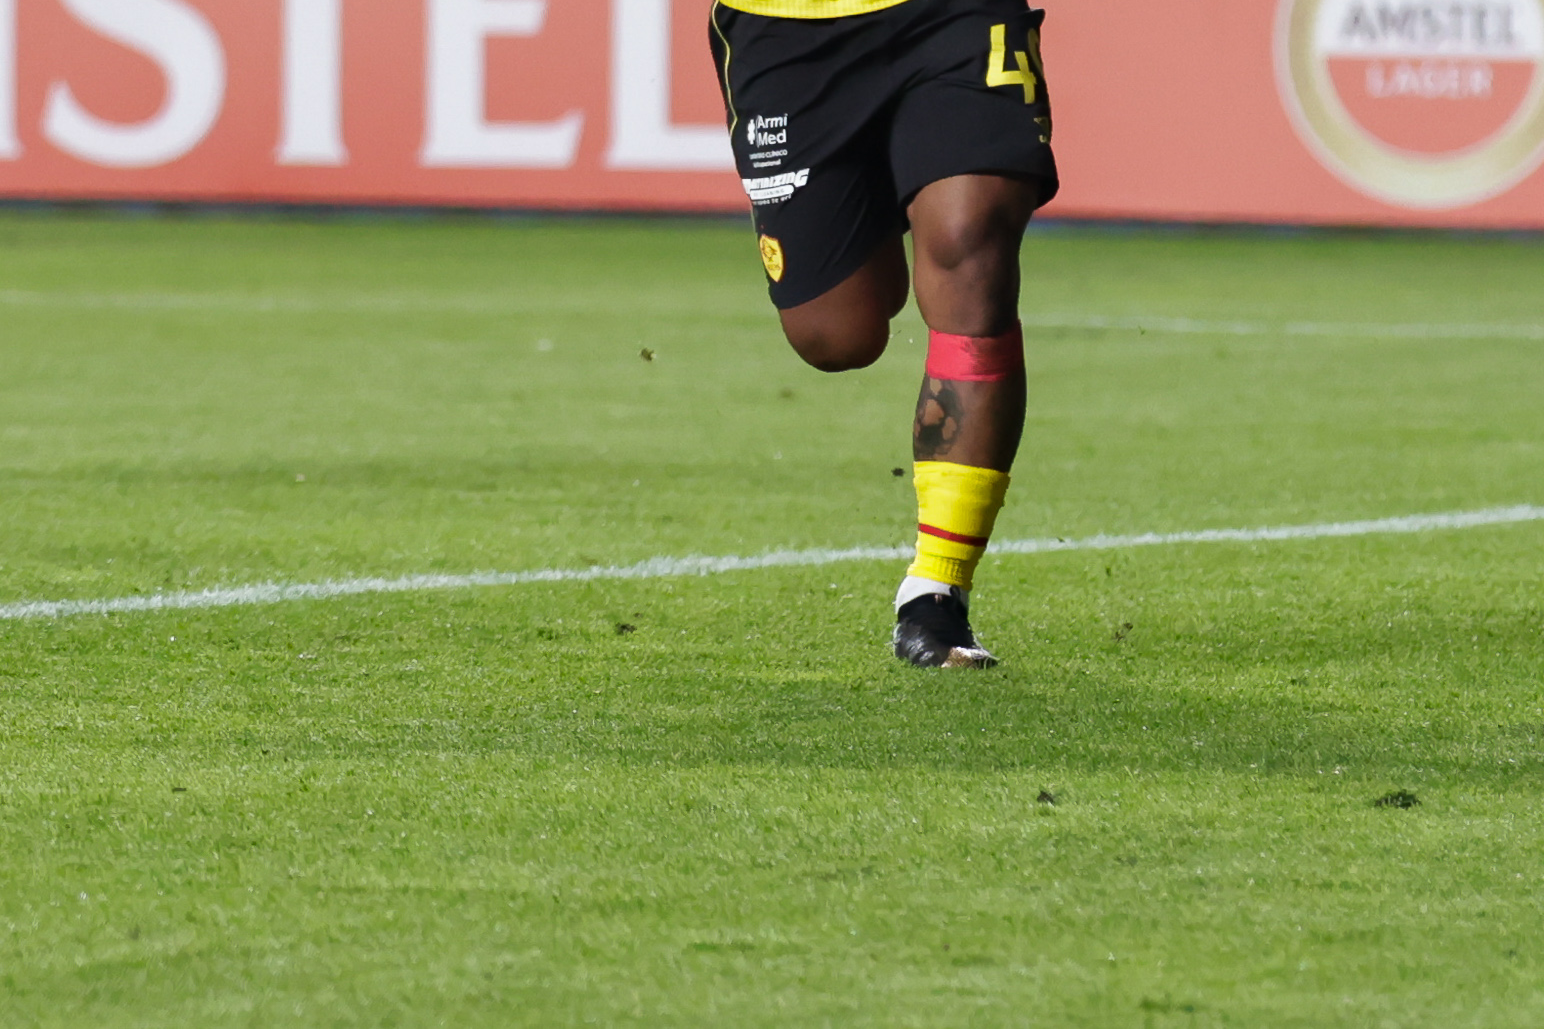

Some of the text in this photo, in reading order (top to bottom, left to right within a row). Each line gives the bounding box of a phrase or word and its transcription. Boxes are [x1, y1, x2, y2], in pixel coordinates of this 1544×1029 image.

[1367, 63, 1493, 98] LAGER
[757, 113, 788, 128] Armi
[757, 129, 787, 146] Med
